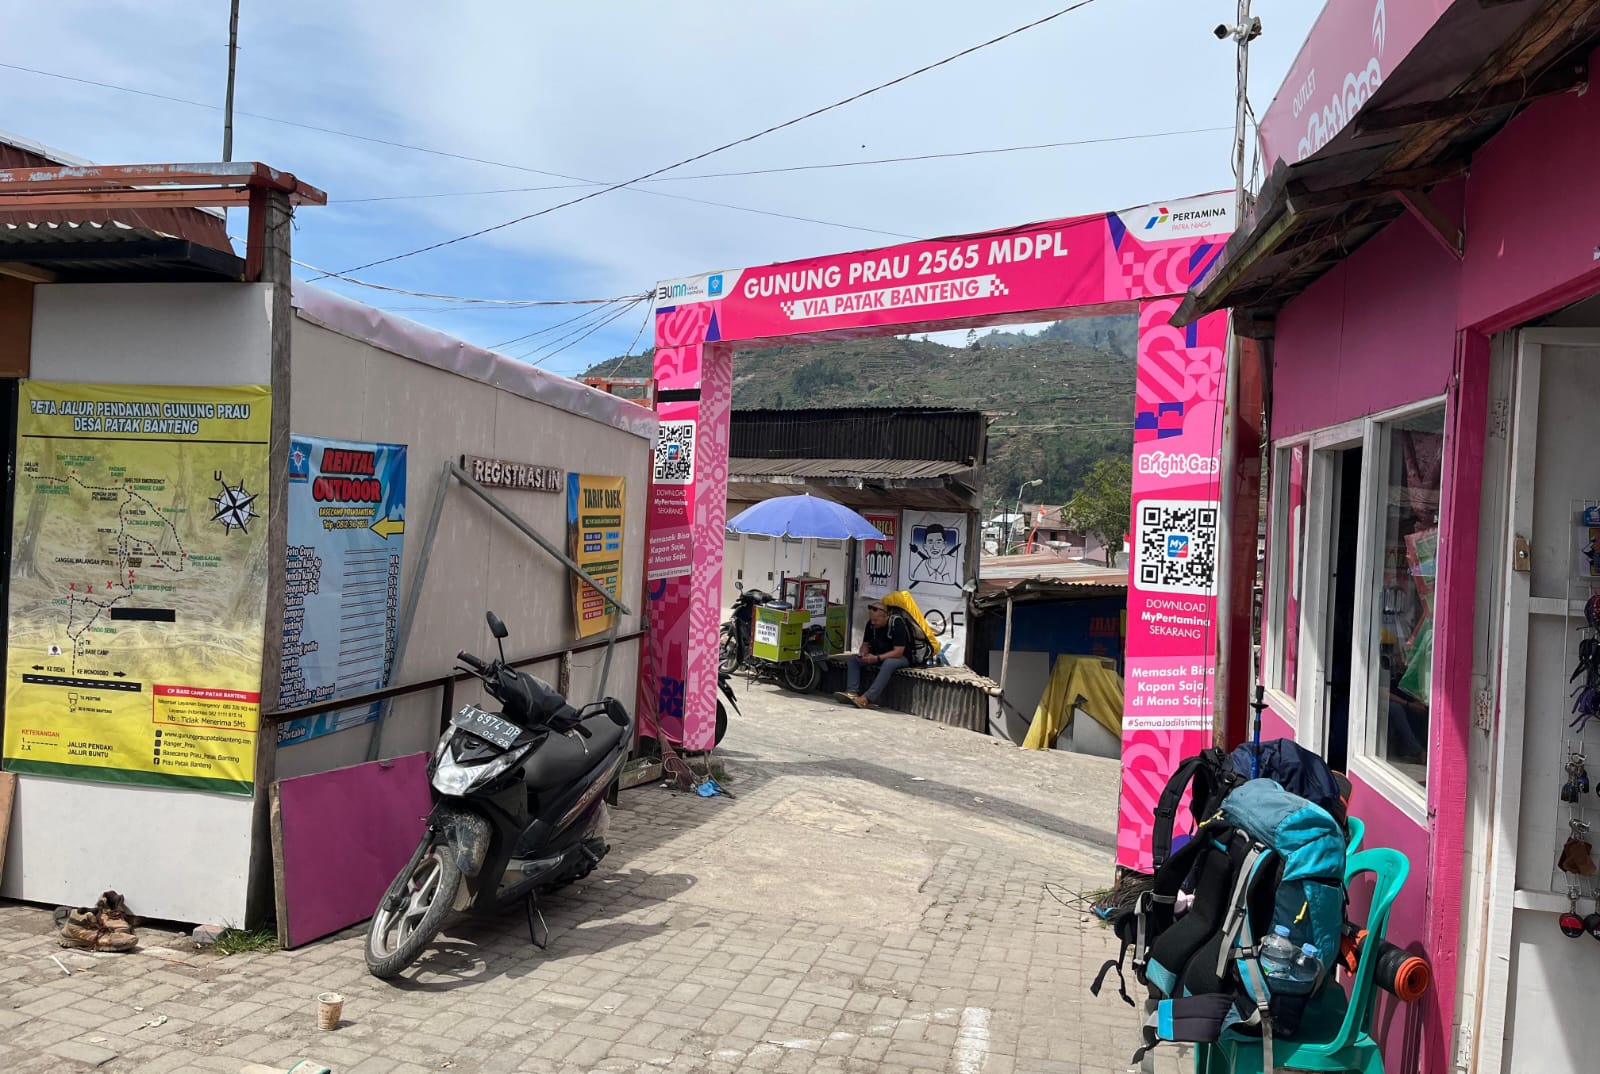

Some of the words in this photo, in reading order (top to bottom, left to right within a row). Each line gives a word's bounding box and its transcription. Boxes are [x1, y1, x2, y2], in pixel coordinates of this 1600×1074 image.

[1293, 67, 1316, 118] OUTLET
[1172, 208, 1226, 221] PERTAMINA
[744, 265, 841, 299] GUNUNG
[849, 255, 910, 284] PRAU
[917, 244, 979, 276] 2565
[988, 232, 1068, 265] MDPL
[802, 299, 828, 316] VIA
[835, 292, 884, 312] PATAK
[890, 279, 979, 305] BANTENG
[59, 401, 94, 416] JALUR
[97, 403, 160, 418] PENDAKIAN
[163, 404, 214, 418] GUNUNG
[217, 404, 250, 419] PRAU
[74, 418, 101, 432] DESA
[104, 418, 141, 432] PATAK
[143, 419, 198, 434] BANTENG
[321, 448, 375, 476] RENTAL
[1139, 451, 1186, 478] Bright
[1187, 454, 1219, 473] Gas
[214, 470, 222, 481] U
[474, 460, 545, 488] REGISTRASI
[548, 470, 560, 490] IN
[313, 476, 382, 503] OUTDOOR
[584, 488, 603, 508] TARIF
[605, 489, 621, 508] OJEK
[650, 546, 669, 554] Kapan
[1170, 540, 1184, 549] My
[866, 553, 892, 577] 10.000
[1146, 599, 1206, 612] DOWNLOAD
[1141, 612, 1210, 626] MyPertamina
[1150, 625, 1200, 639] SEKARANG
[1132, 666, 1186, 677] Memasak
[1138, 681, 1175, 694] Kapan
[1133, 696, 1143, 706] di
[1147, 696, 1179, 706] Mana
[459, 707, 476, 720] AA
[202, 718, 231, 726] Menerima
[22, 729, 60, 737] KETERANGAN
[190, 760, 211, 769] Banteng
